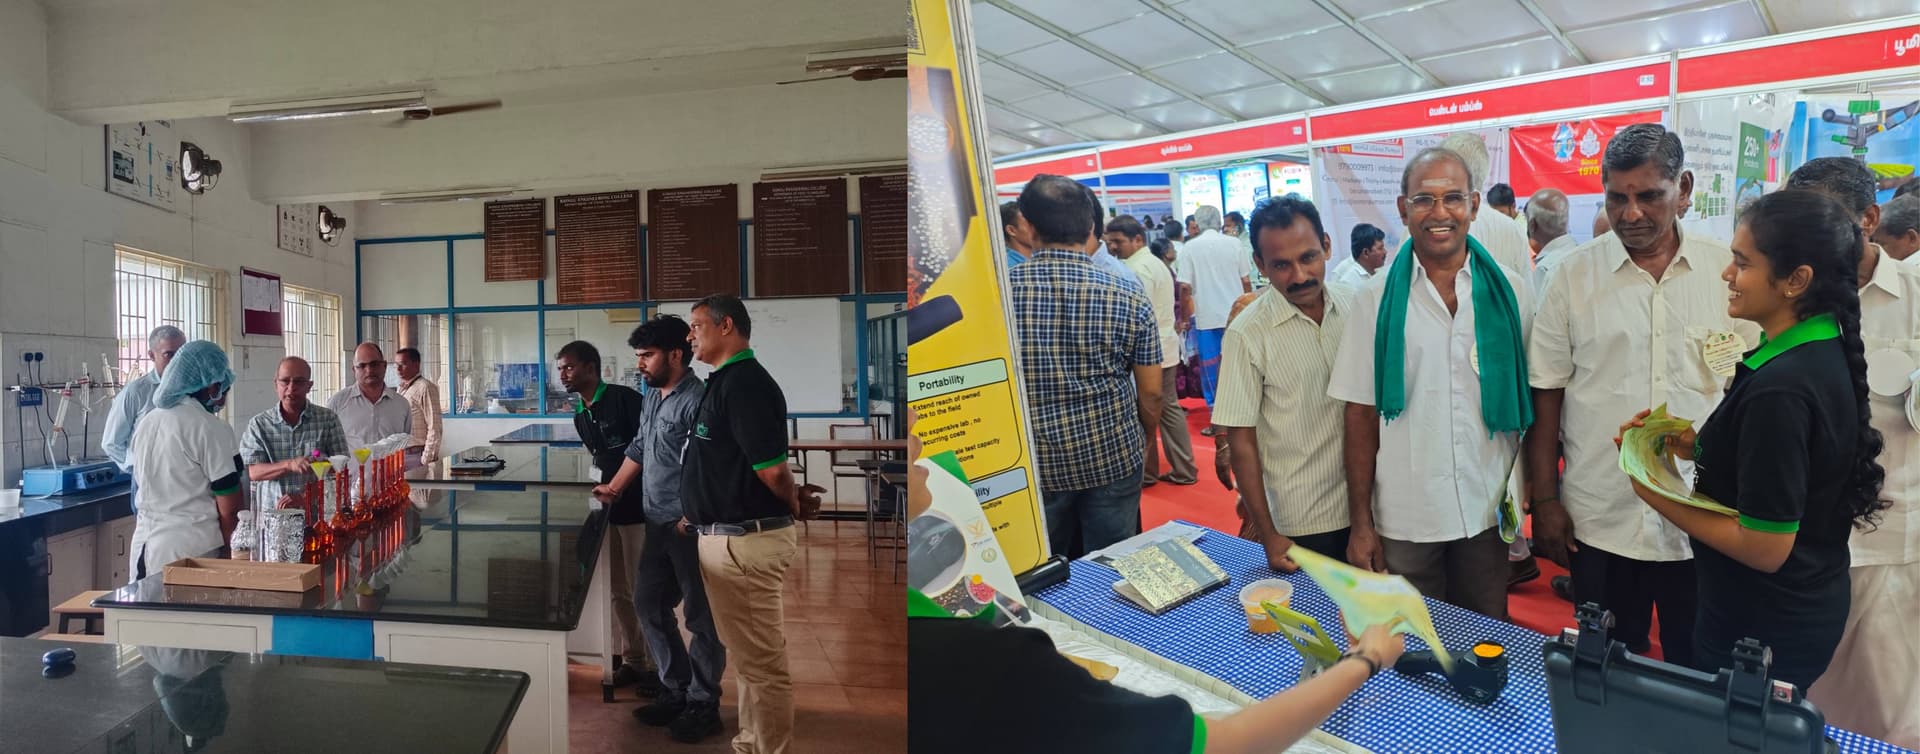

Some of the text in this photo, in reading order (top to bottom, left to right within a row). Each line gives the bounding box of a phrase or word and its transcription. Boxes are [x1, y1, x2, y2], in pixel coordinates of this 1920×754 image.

[1578, 165, 1600, 176] 1970
[918, 375, 965, 391] Portability
[912, 401, 935, 412] Extend
[936, 397, 953, 407] reach
[961, 391, 981, 400] owned
[936, 406, 947, 415] the
[947, 403, 961, 412] field
[918, 430, 928, 438] No
[929, 422, 959, 435] expensive
[959, 419, 969, 427] lab
[922, 429, 966, 447] ecurring costs
[965, 443, 977, 452] test
[977, 437, 1000, 449] capacity
